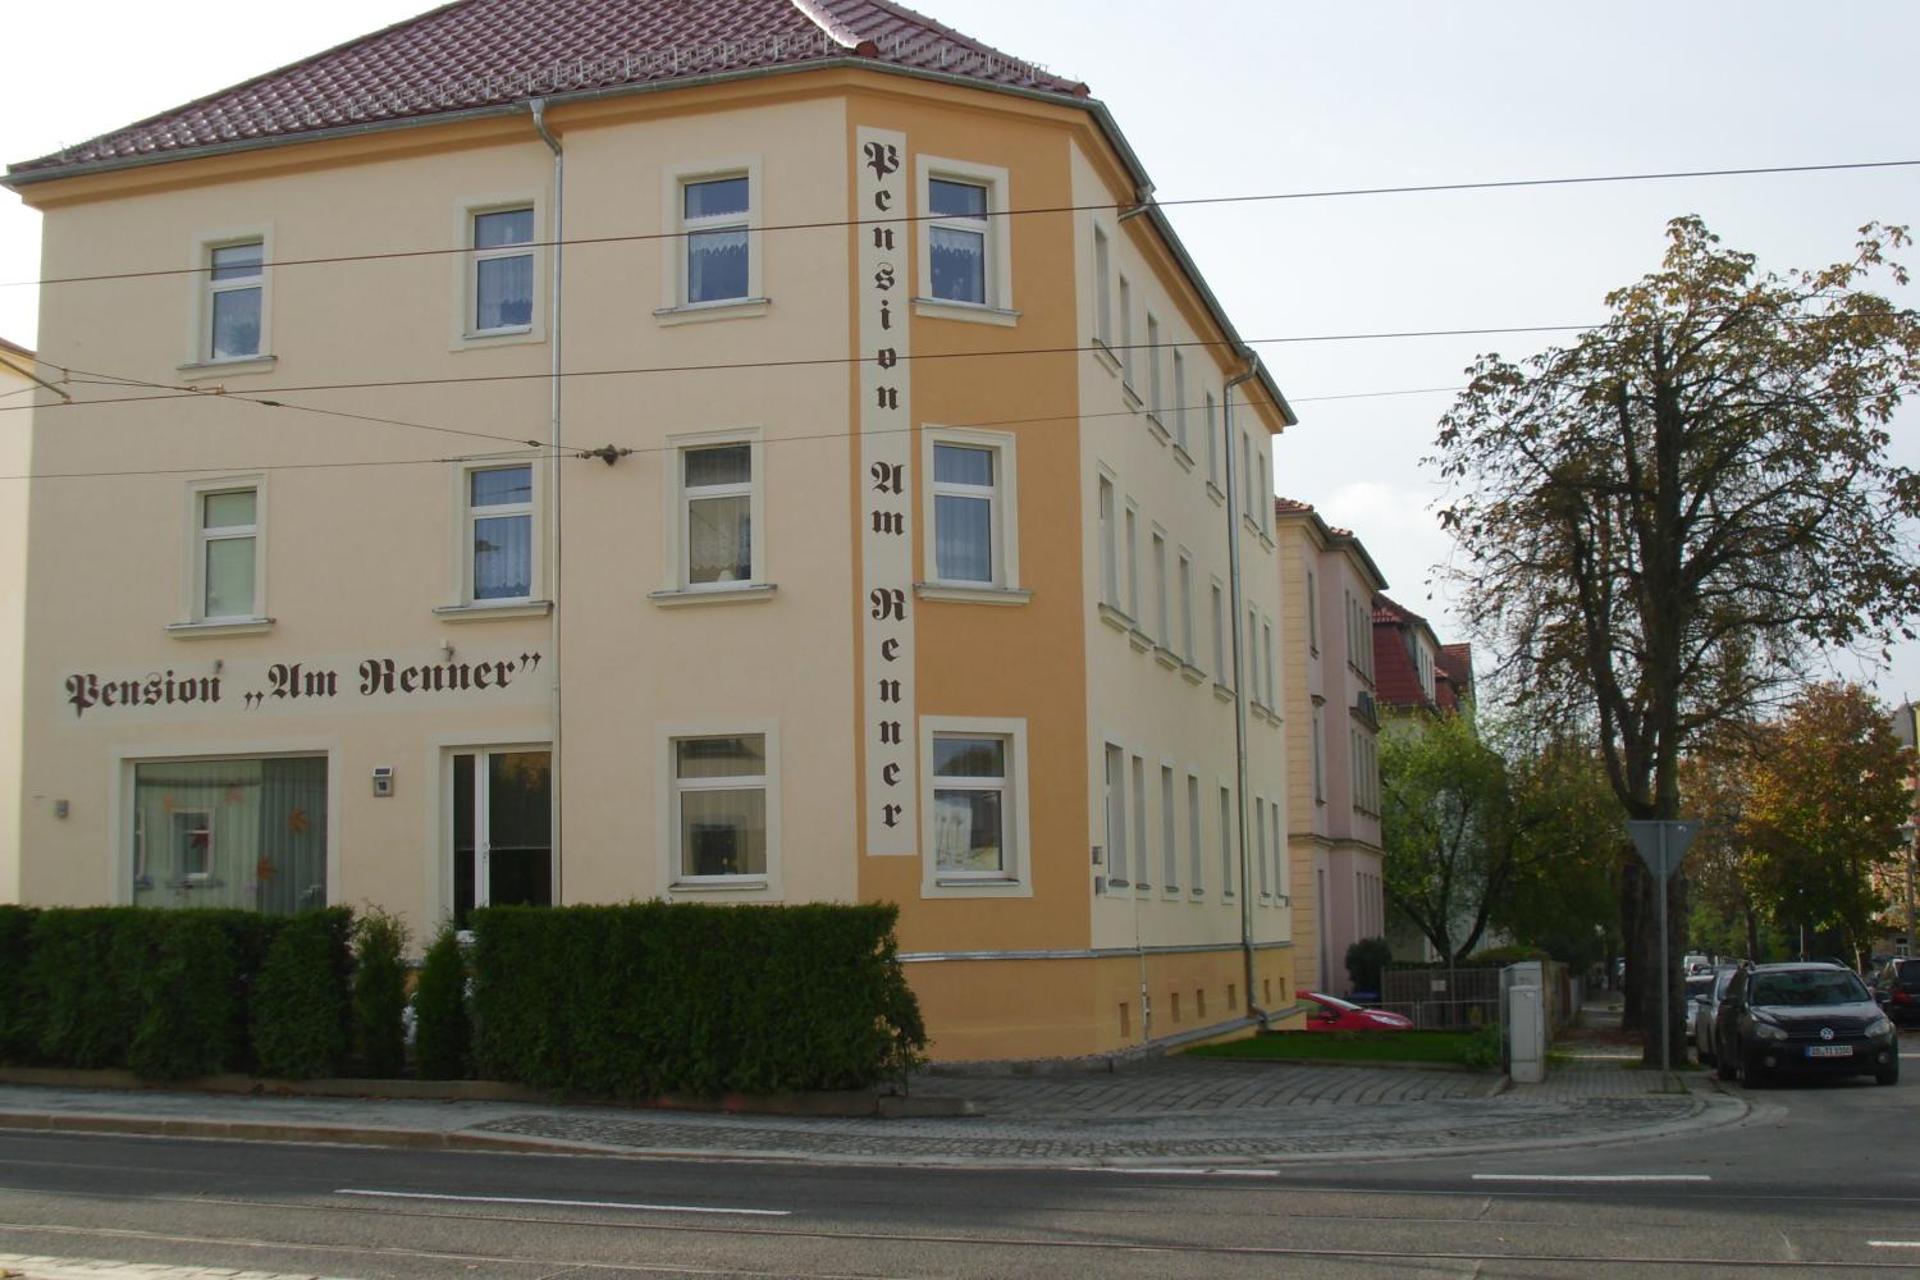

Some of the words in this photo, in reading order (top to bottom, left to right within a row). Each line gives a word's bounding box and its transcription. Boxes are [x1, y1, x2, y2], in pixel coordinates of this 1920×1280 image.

[863, 141, 900, 410] Pension
[870, 461, 905, 537] Am
[65, 669, 221, 718] Pension
[870, 587, 907, 829] Renner
